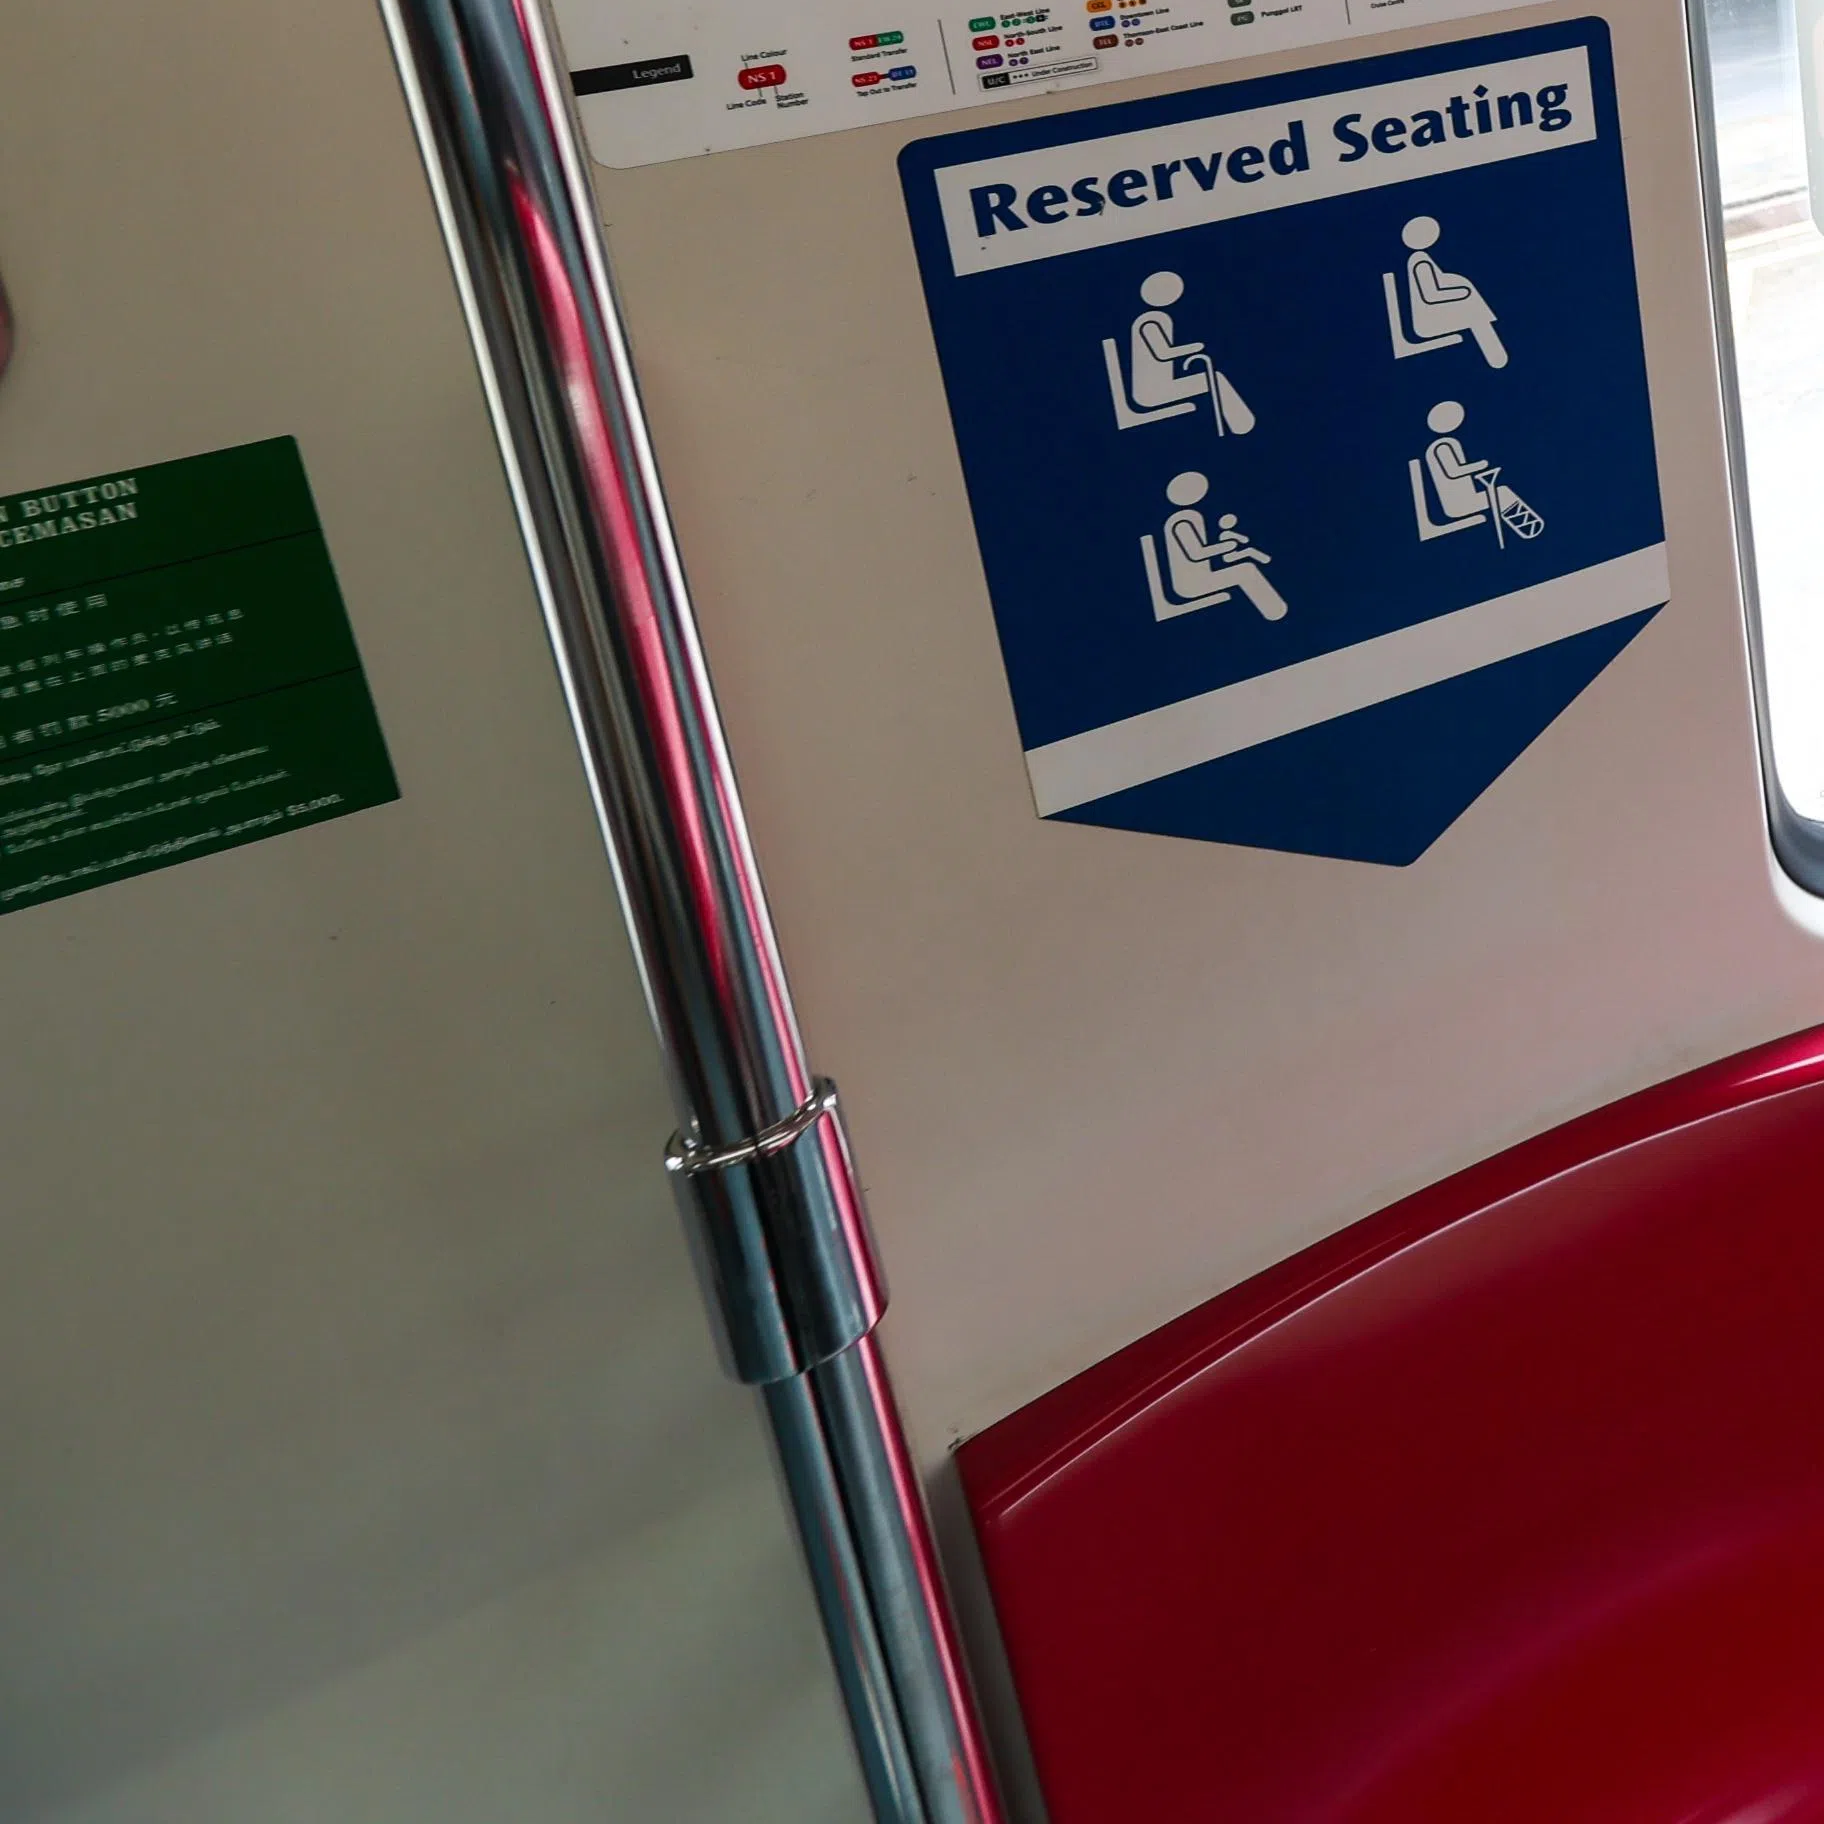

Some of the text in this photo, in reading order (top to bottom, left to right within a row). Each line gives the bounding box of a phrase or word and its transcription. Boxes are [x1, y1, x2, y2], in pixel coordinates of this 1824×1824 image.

[632, 63, 682, 81] Legend
[747, 71, 766, 84] NS
[969, 76, 1574, 239] Reserved Seating
[20, 478, 139, 518] BUTTON
